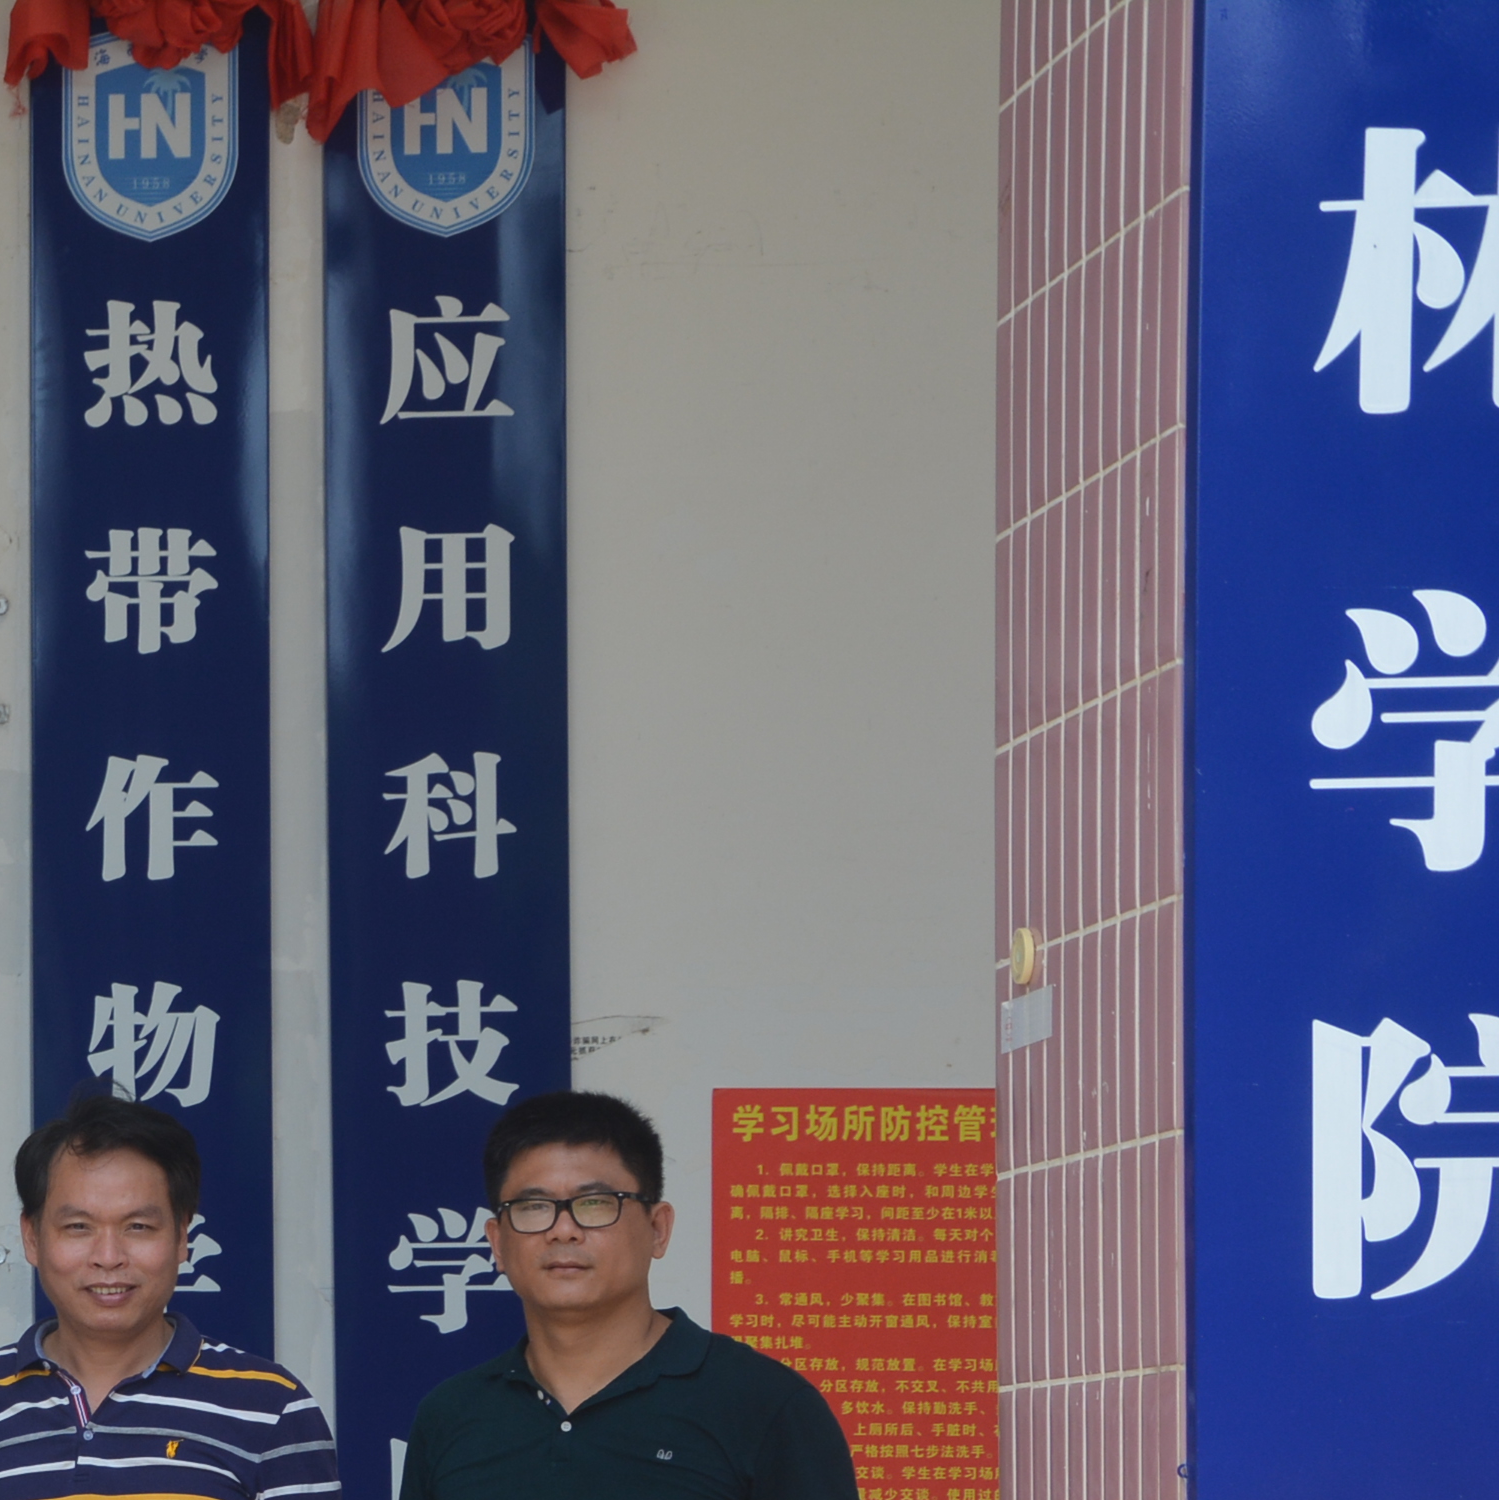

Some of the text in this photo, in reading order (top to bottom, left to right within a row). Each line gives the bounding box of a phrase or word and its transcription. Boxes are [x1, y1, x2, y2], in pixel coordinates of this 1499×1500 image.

[108, 93, 191, 160] HN
[404, 87, 487, 155] HN
[132, 177, 171, 189] 1958
[428, 173, 466, 185] 1958
[84, 299, 221, 1296] 热带作物
[732, 1104, 996, 1142] 学习场所防控管
[730, 1206, 996, 1220] 离，隔排、隔座学习，间距至少在1米以
[730, 1315, 997, 1328] 学习时，尽可能主动开窗通风，保持室
[781, 1358, 998, 1372] 分区存放，规范放置。在学习场
[841, 1401, 999, 1415] 多饮水。保持勤洗手、
